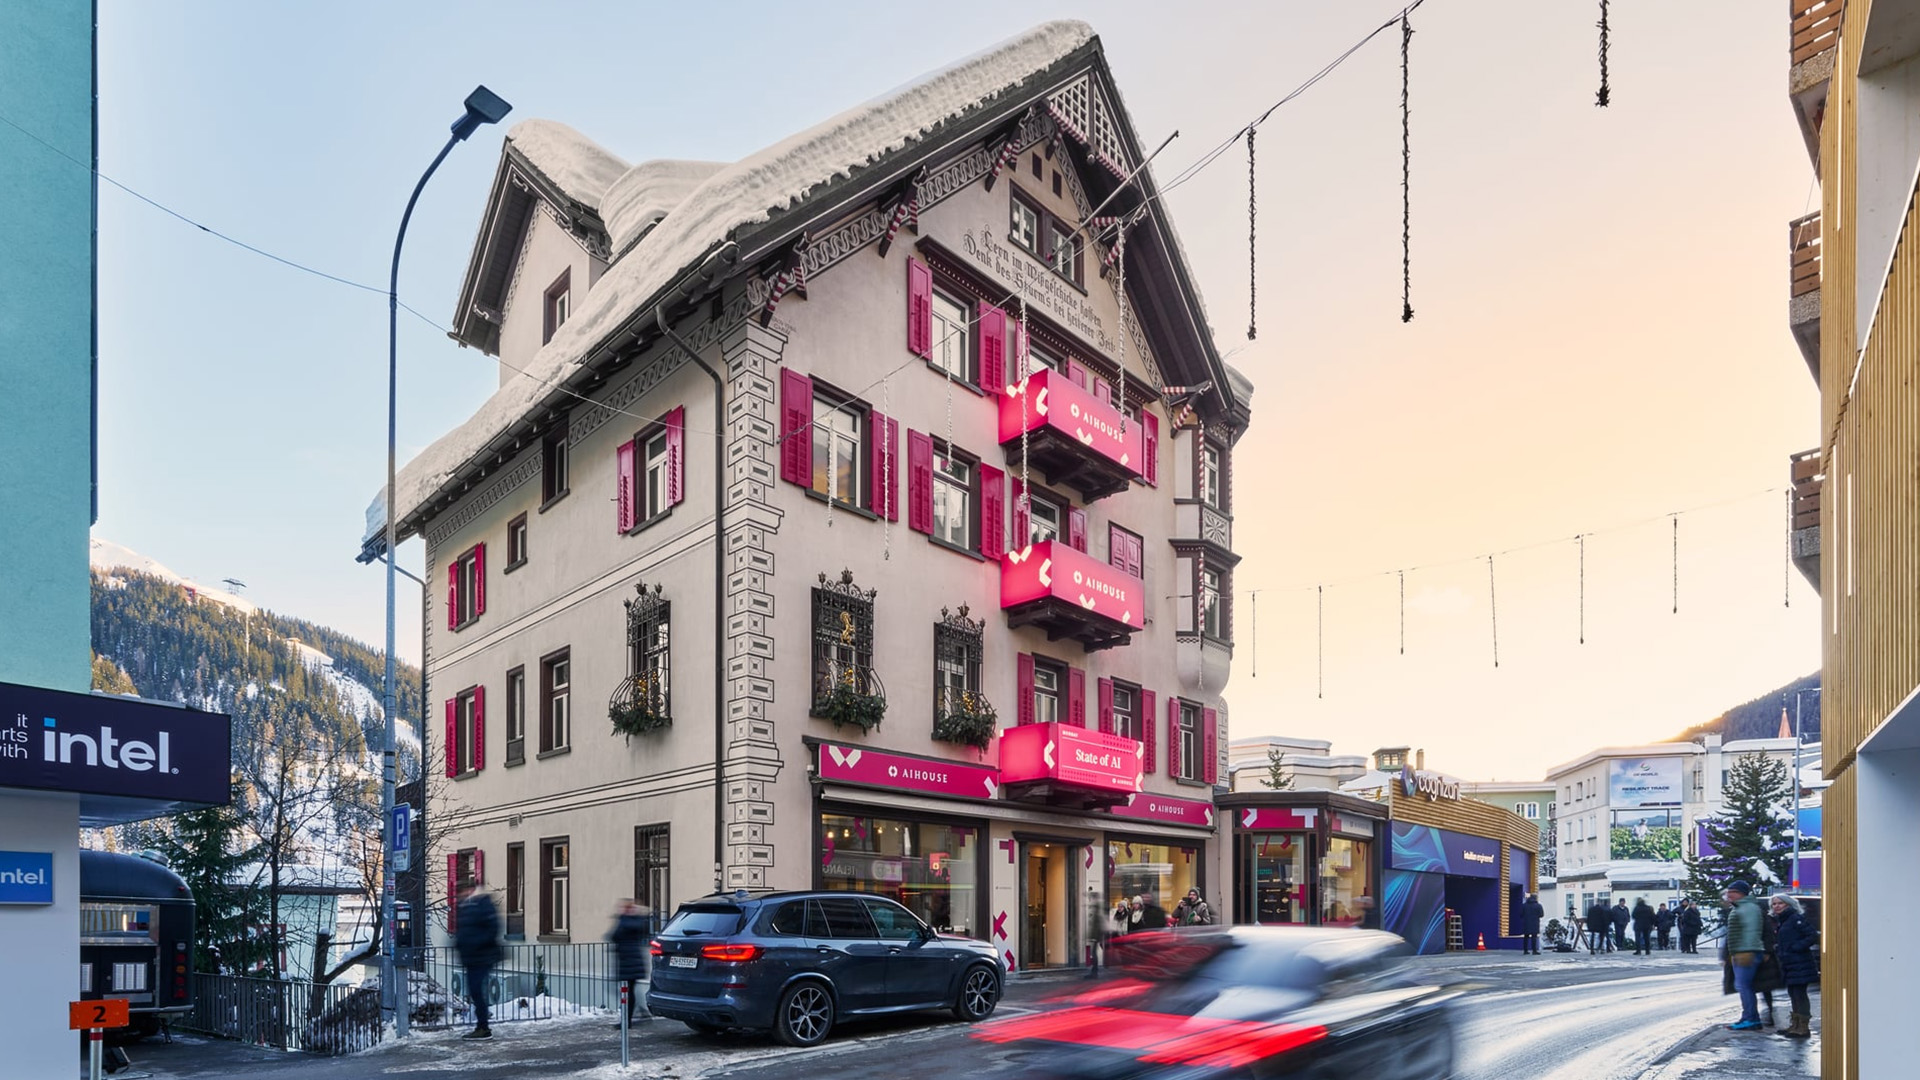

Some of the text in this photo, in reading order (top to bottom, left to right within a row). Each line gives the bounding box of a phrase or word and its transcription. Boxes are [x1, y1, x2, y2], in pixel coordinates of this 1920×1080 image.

[963, 229, 992, 268] Denk
[1012, 252, 1022, 271] im
[17, 713, 28, 728] it
[0, 727, 28, 743] rts
[1076, 748, 1121, 769] State of AI
[396, 813, 404, 847] P
[0, 868, 45, 885] ntel
[93, 1005, 107, 1023] 2
